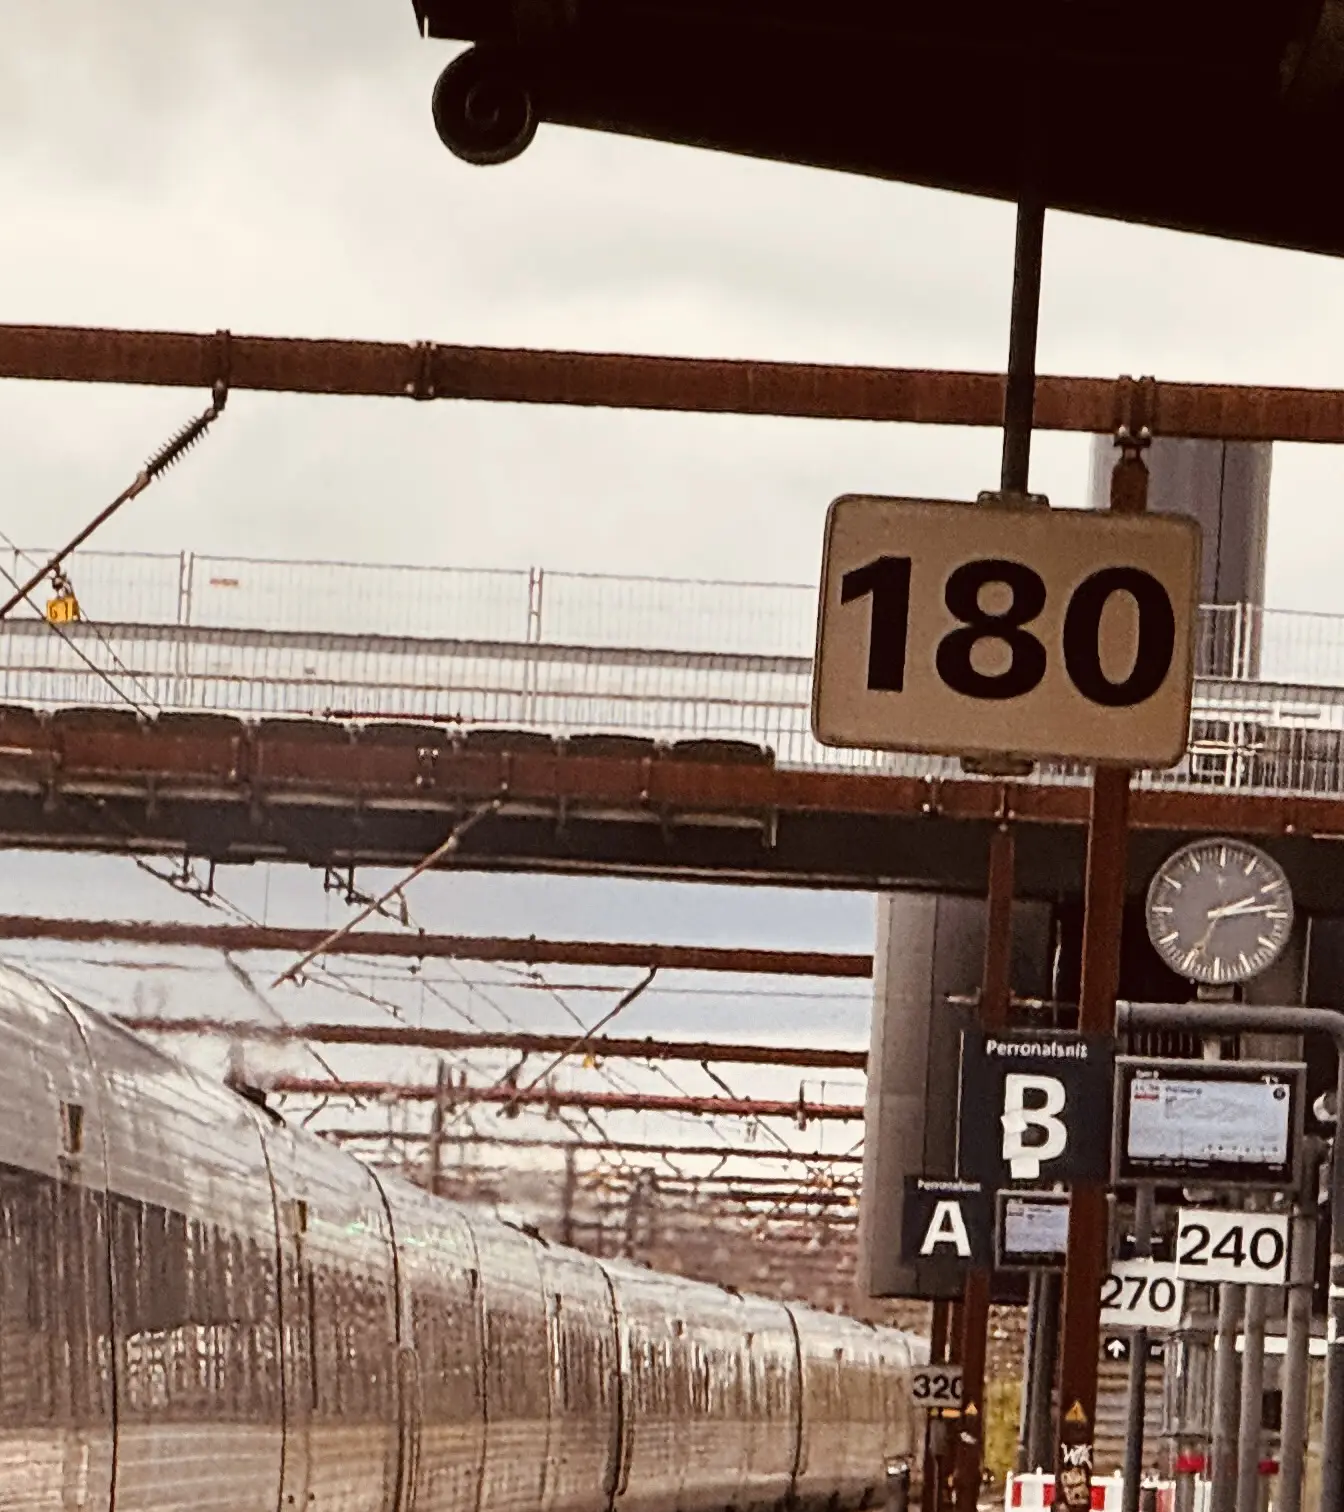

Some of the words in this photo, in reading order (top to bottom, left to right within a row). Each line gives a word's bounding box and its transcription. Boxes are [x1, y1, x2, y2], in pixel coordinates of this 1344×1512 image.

[840, 555, 1176, 708] 180
[1002, 1072, 1068, 1161] B
[920, 1199, 972, 1257] A
[1179, 1223, 1284, 1270] 240
[1100, 1273, 1176, 1313] 270
